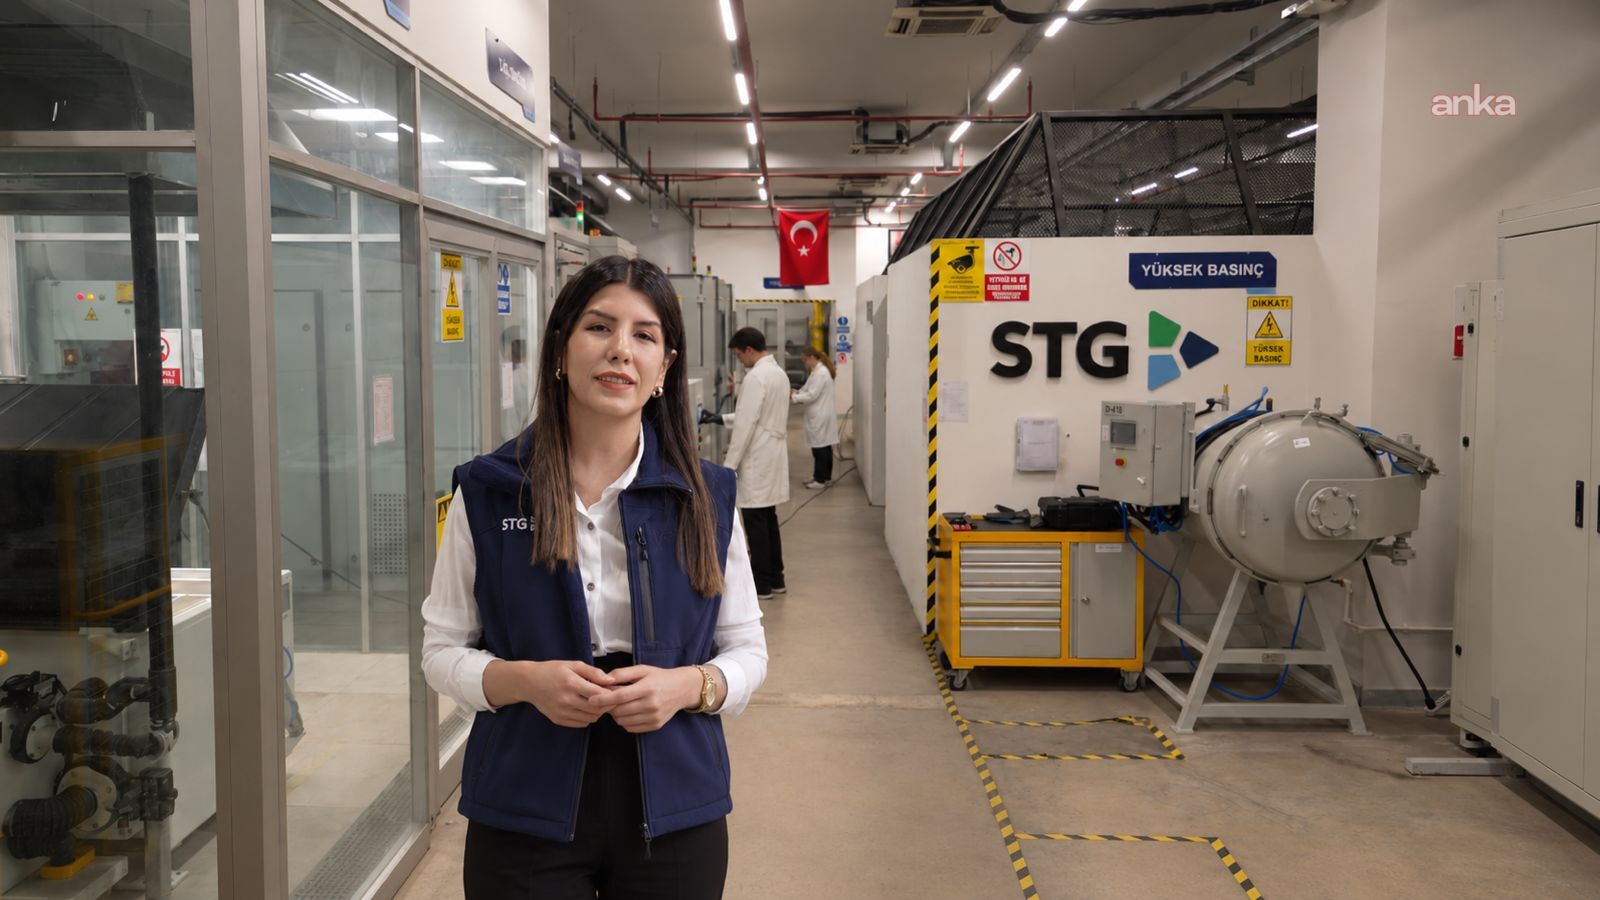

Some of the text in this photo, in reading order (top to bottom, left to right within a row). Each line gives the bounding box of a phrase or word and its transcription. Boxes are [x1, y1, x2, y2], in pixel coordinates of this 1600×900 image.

[1141, 261, 1264, 279] YÜKSEK BASINÇ
[990, 320, 1130, 379] STG
[501, 517, 528, 531] STG
